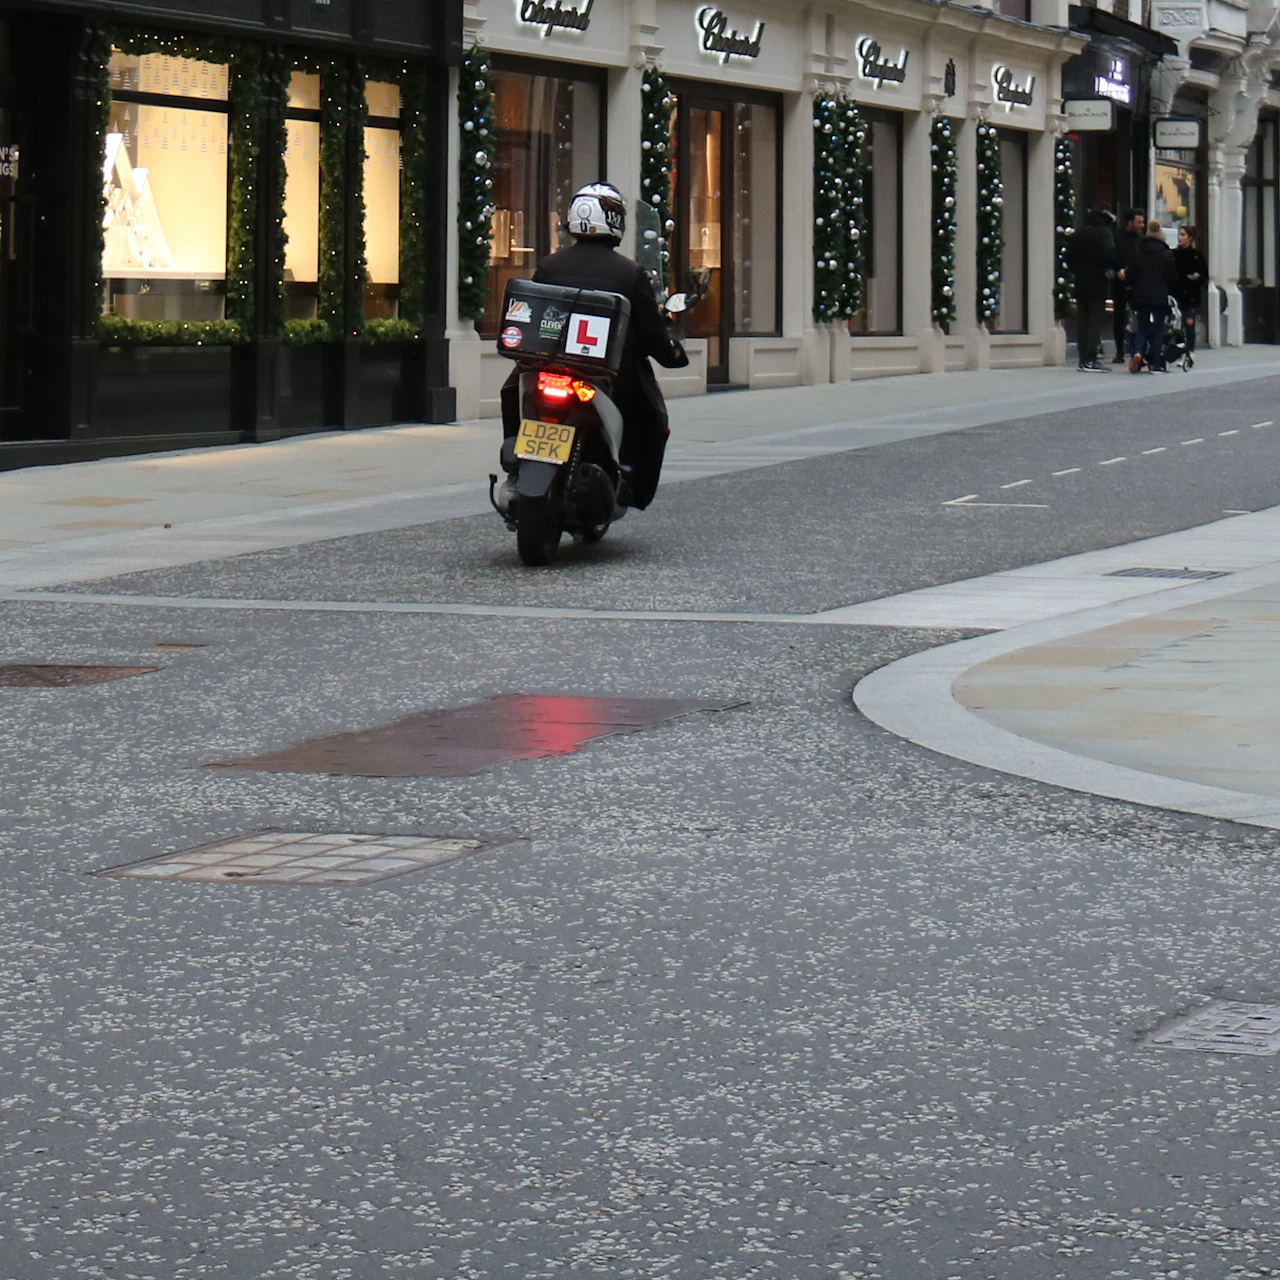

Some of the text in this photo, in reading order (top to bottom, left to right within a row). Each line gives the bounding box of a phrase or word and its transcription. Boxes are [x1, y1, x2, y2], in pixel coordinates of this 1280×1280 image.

[698, 6, 766, 64] Chopard
[858, 37, 910, 89] Chopard
[995, 65, 1036, 112] Chopard
[540, 319, 563, 330] CLEVER
[576, 319, 598, 347] L
[521, 422, 571, 443] LD20
[524, 439, 562, 458] SFK
